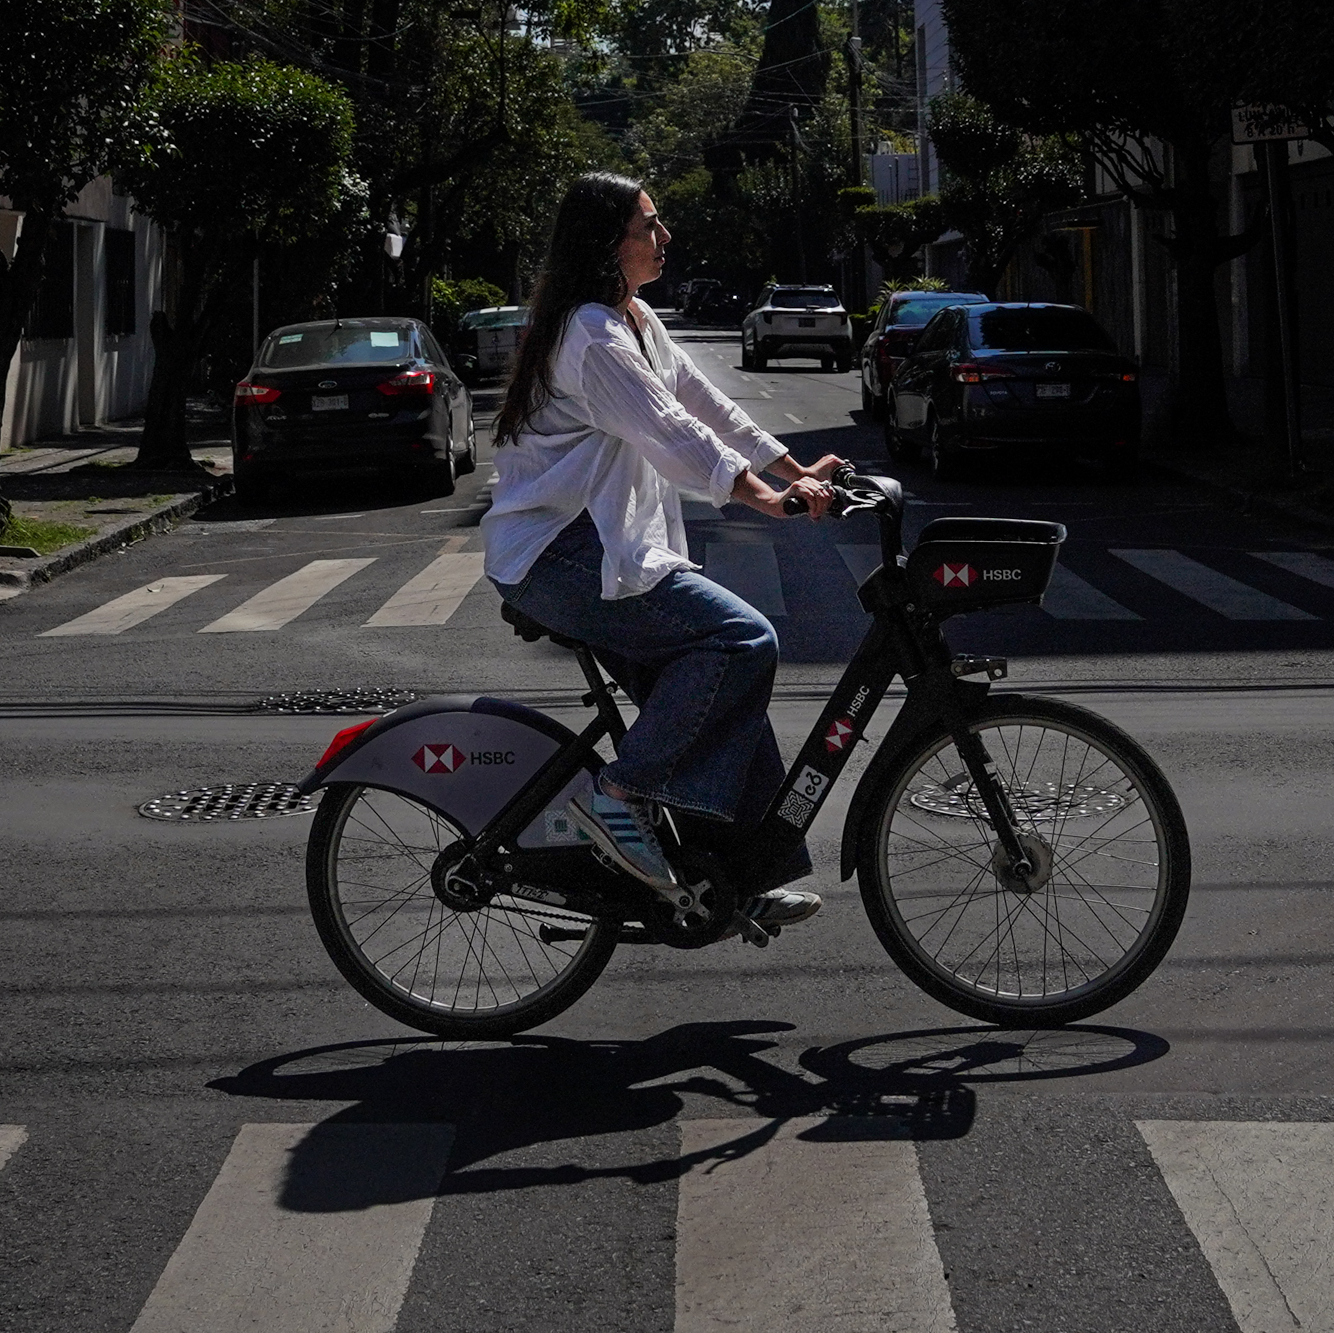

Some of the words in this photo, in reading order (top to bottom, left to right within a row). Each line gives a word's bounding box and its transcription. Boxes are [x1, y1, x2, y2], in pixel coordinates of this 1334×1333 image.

[983, 569, 1022, 580] HSBC
[847, 685, 870, 717] HSBC
[470, 751, 515, 765] HSBC
